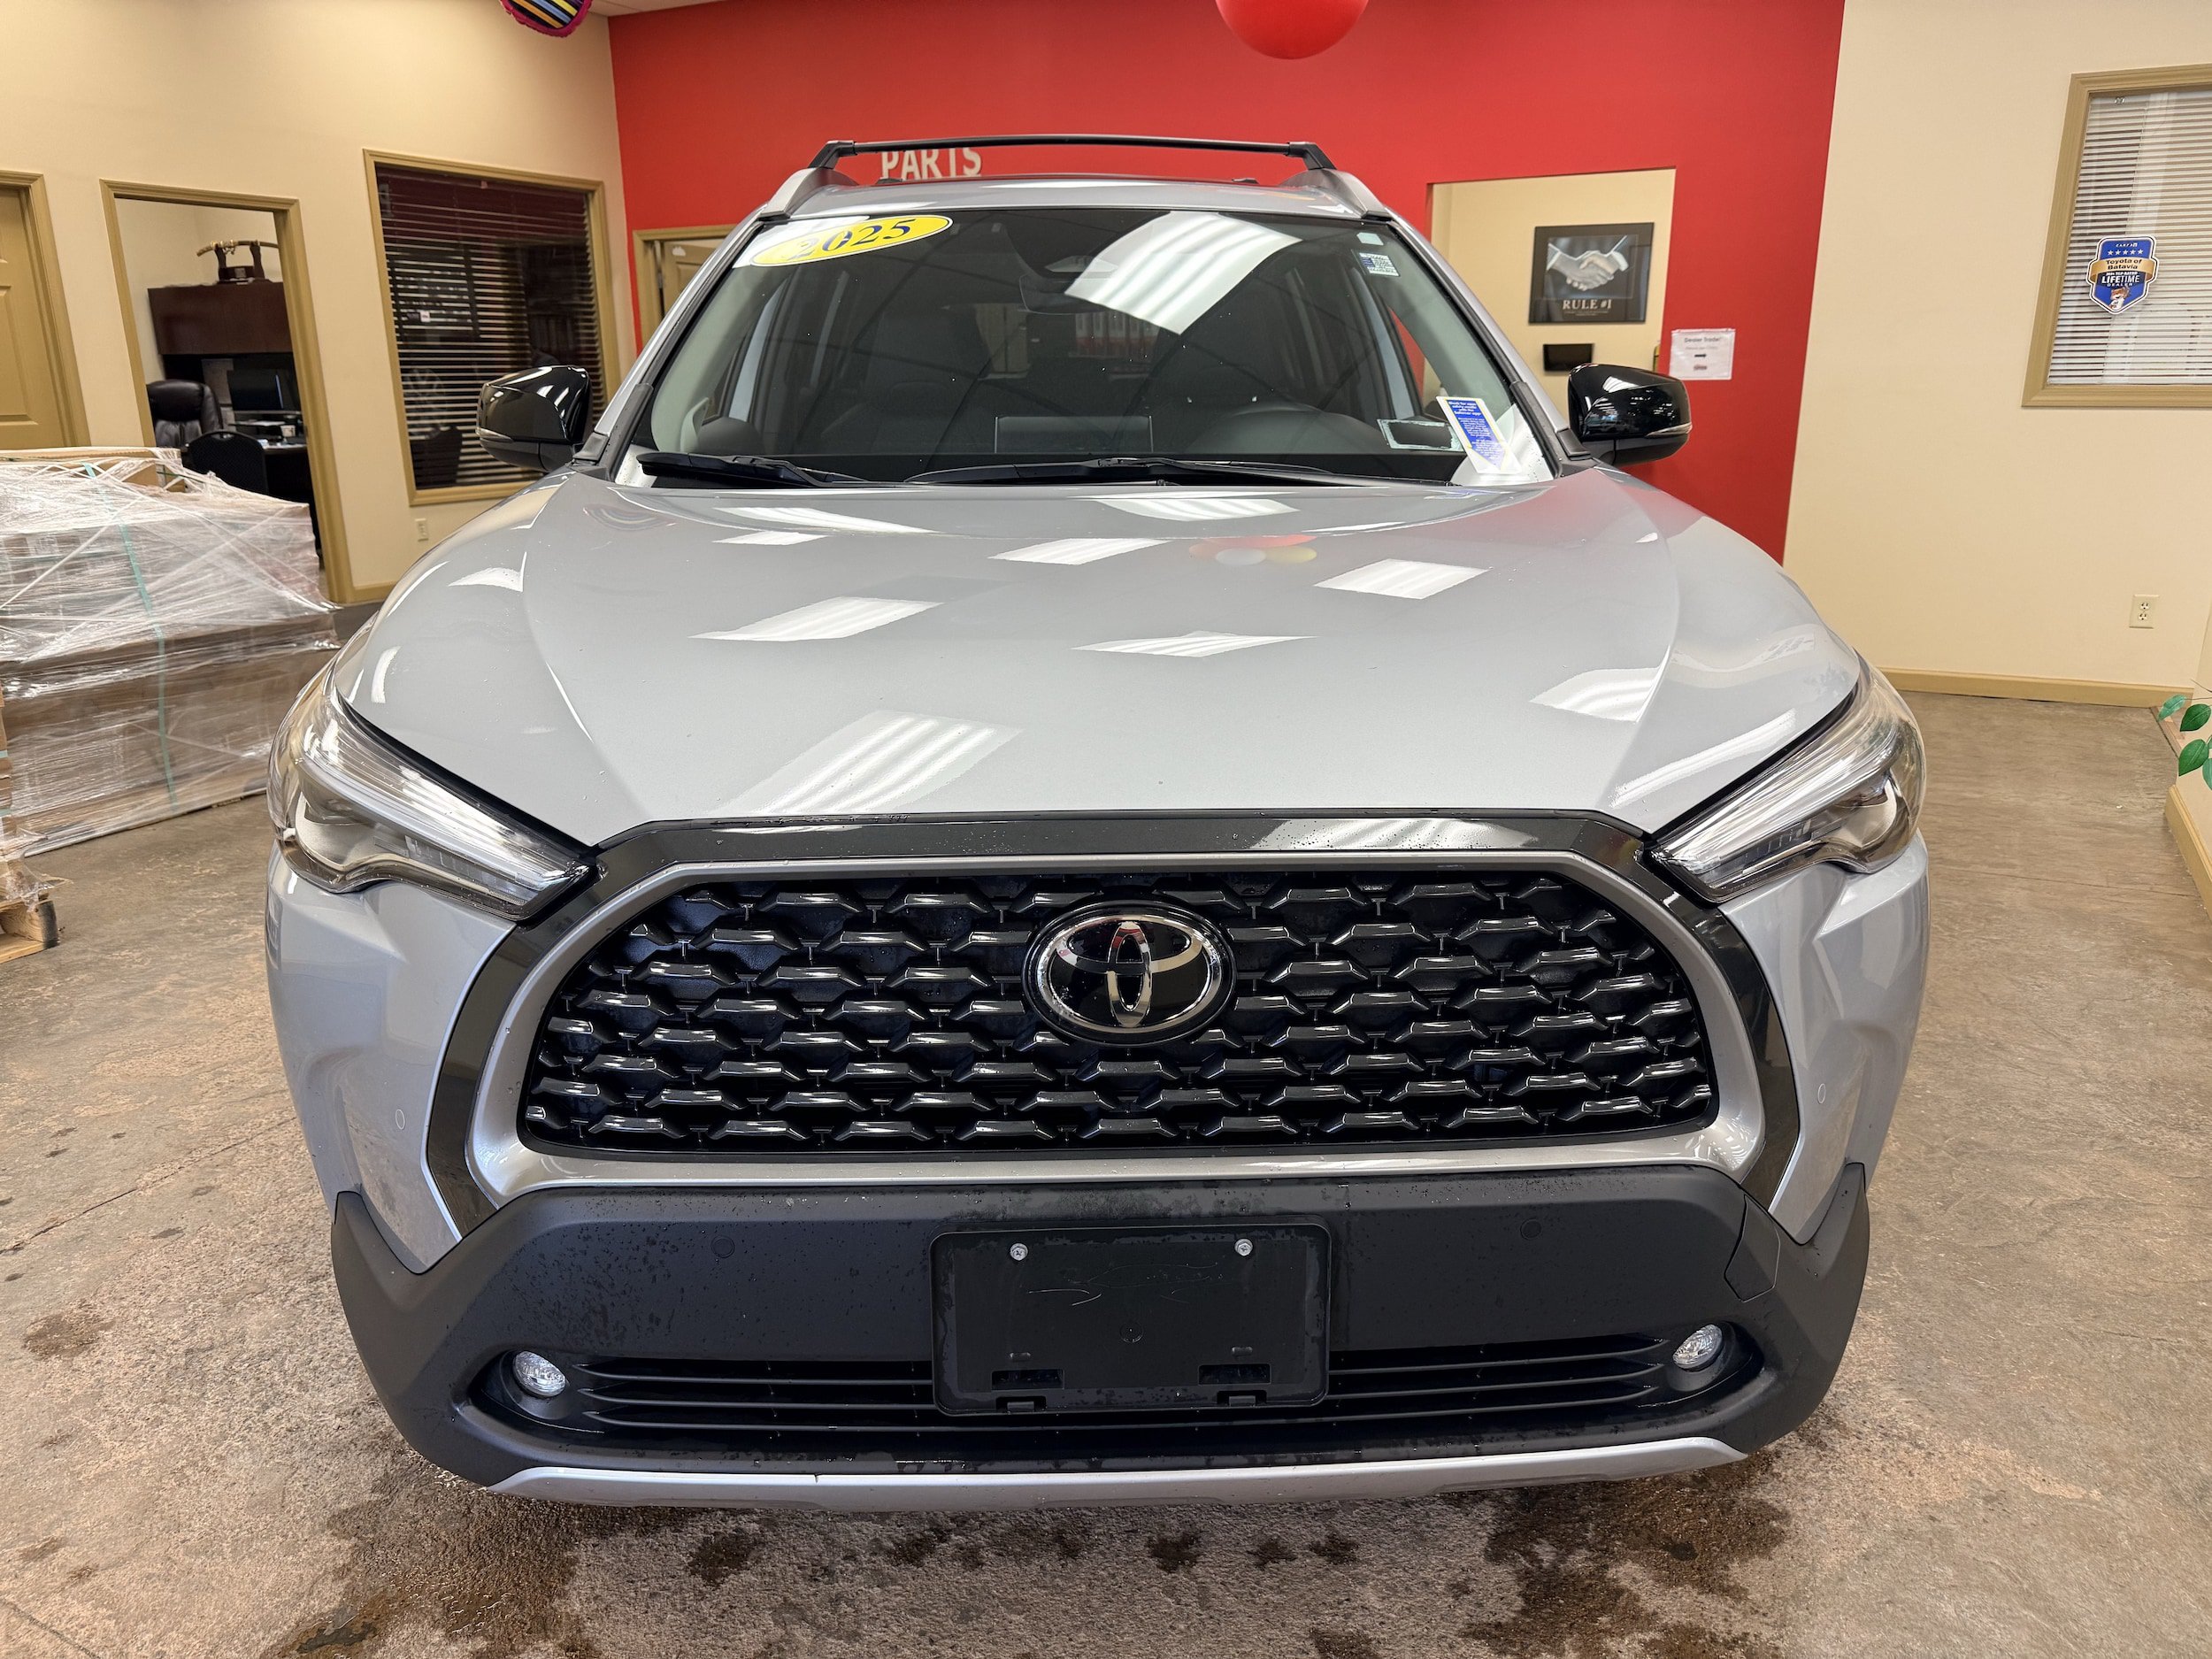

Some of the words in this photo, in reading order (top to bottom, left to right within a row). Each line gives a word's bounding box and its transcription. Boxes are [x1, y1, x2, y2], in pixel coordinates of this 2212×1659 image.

[880, 147, 982, 180] PARTS
[787, 219, 917, 260] 2025
[1563, 299, 1598, 310] RULE
